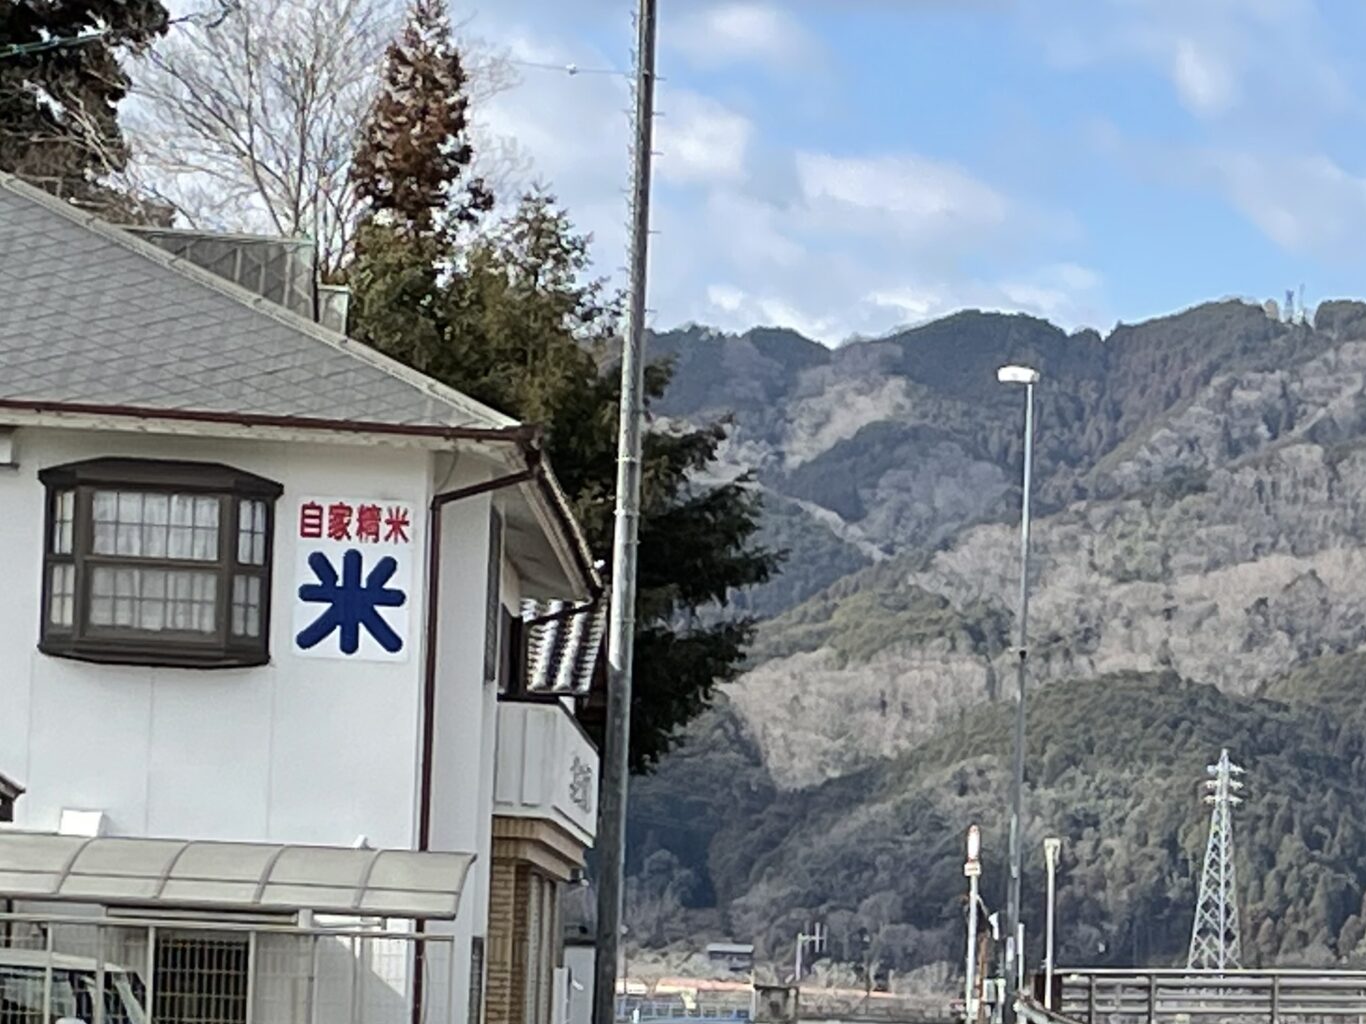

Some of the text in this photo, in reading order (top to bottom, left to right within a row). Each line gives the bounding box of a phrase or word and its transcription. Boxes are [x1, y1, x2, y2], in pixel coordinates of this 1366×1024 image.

[300, 501, 410, 543] 自家精米
[296, 548, 407, 655] 米
